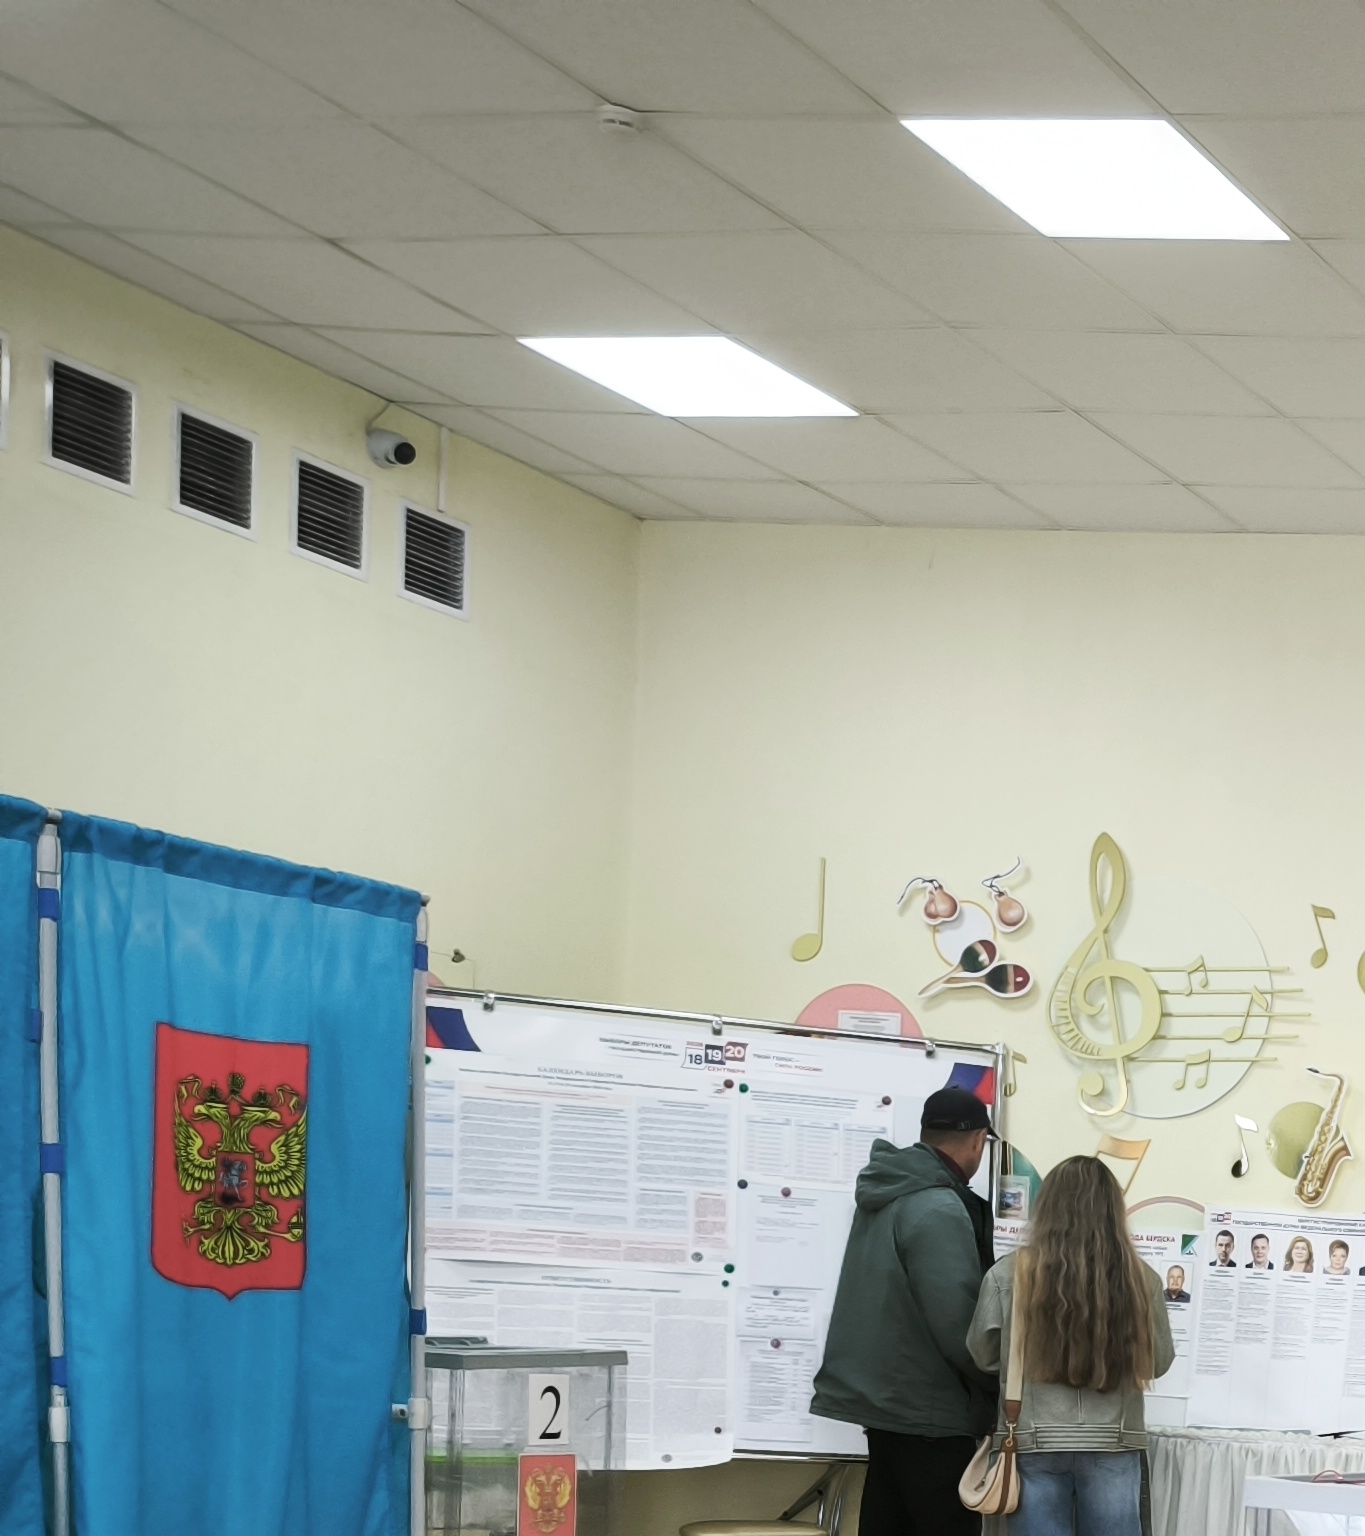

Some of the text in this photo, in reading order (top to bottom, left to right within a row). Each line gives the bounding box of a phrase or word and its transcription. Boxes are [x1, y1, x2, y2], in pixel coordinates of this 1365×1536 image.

[706, 1048, 722, 1061] 19
[725, 1045, 745, 1059] 20
[688, 1053, 703, 1065] 18
[539, 1385, 562, 1440] 2
